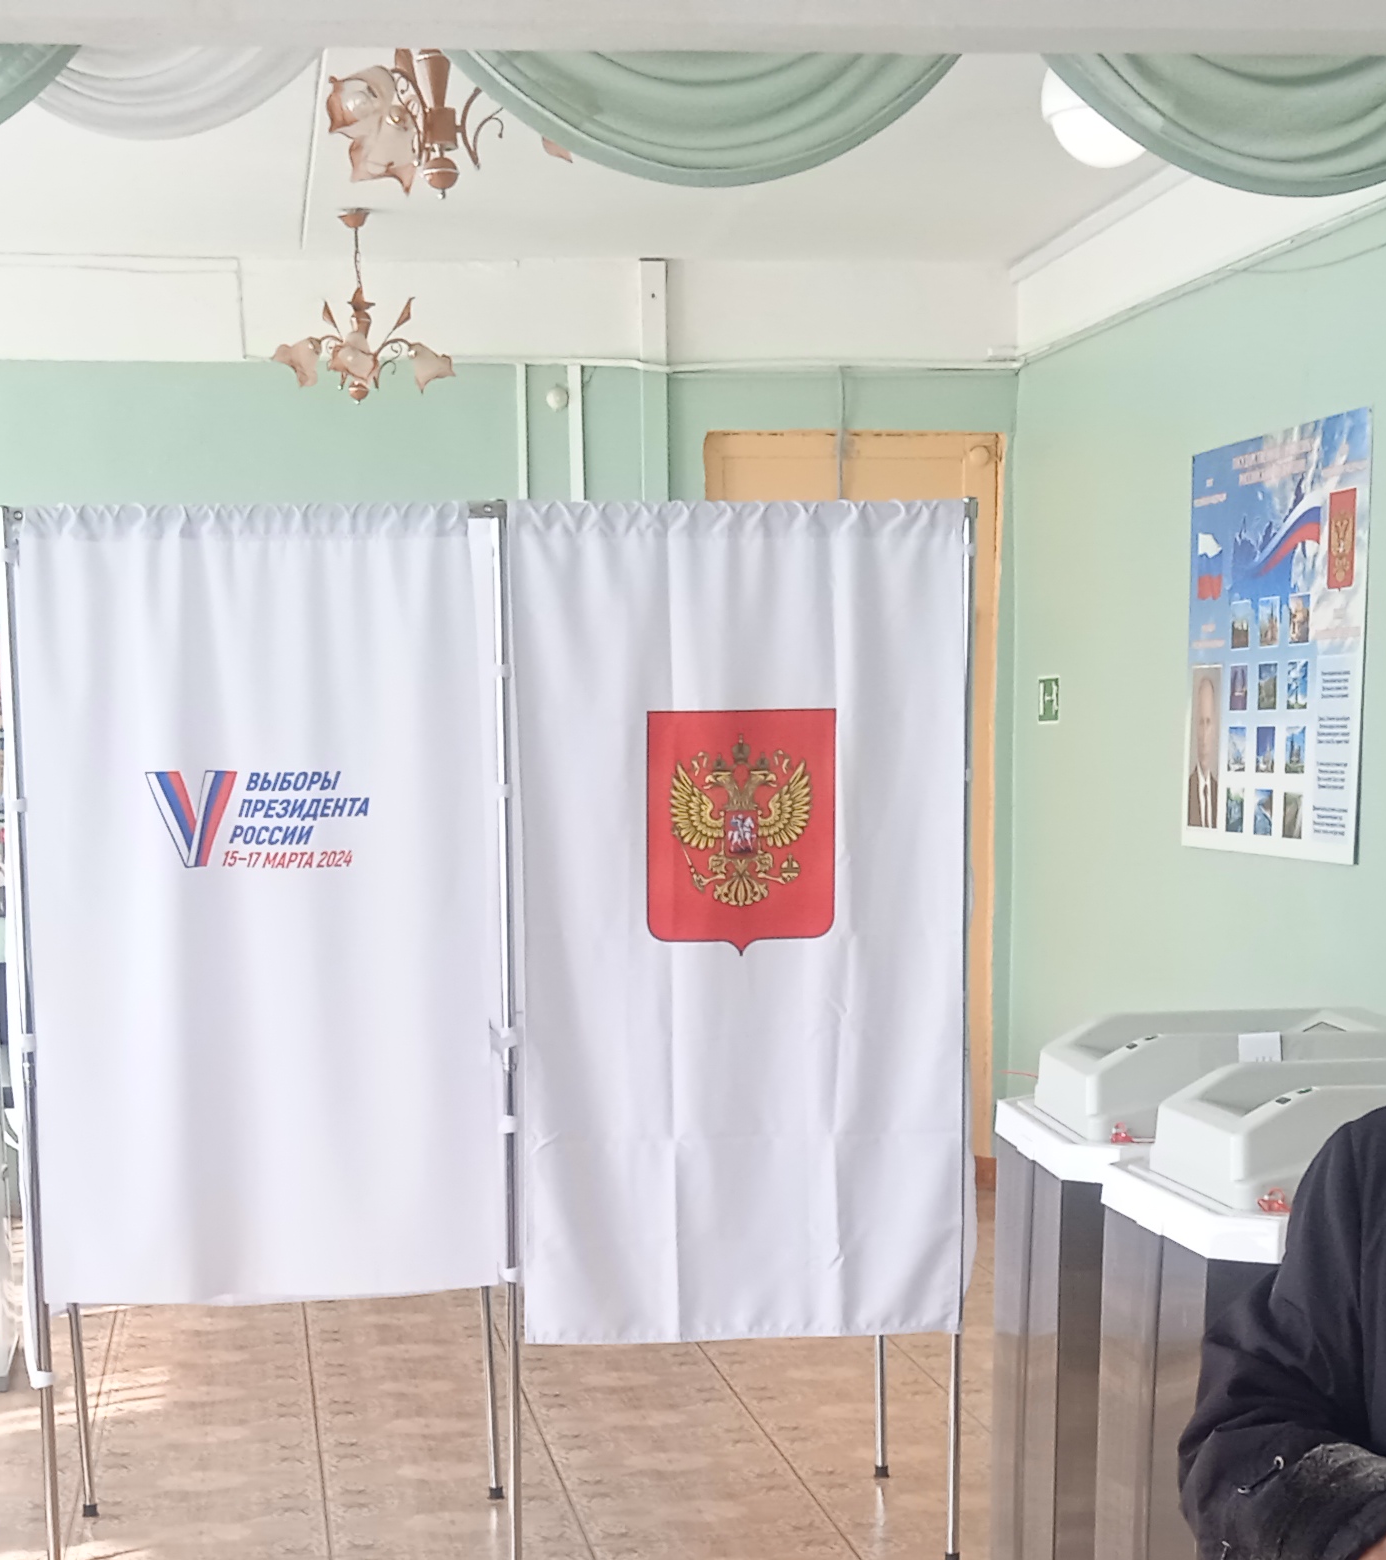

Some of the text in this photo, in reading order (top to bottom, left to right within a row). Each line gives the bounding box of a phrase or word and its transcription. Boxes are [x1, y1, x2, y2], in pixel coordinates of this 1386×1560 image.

[245, 770, 342, 792] ВЫБОРЫ
[238, 797, 371, 821] ПРЕЗИДЕНТА
[228, 824, 315, 846] РОССИИ
[262, 851, 314, 869] МАРТА
[316, 849, 353, 868] 2024
